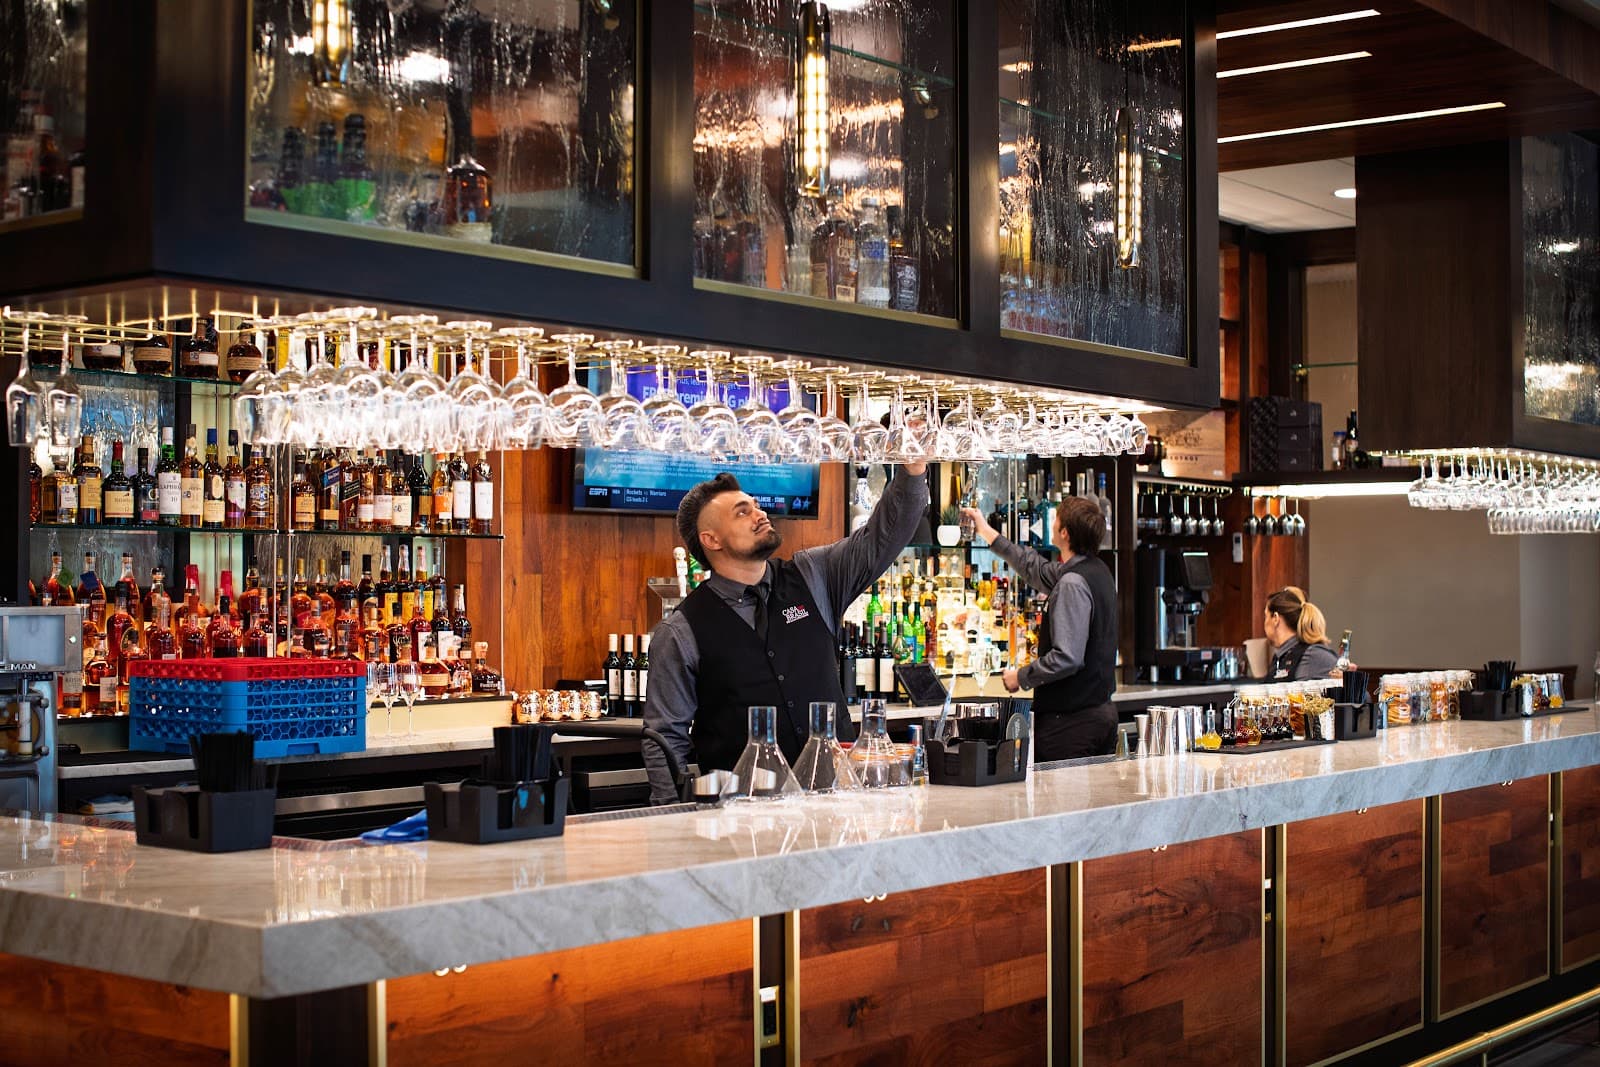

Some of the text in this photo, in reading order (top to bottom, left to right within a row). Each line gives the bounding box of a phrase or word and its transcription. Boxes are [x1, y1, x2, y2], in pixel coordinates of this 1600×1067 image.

[589, 487, 608, 496] ESPN
[782, 605, 798, 616] CASA
[786, 608, 808, 621] BRASIL
